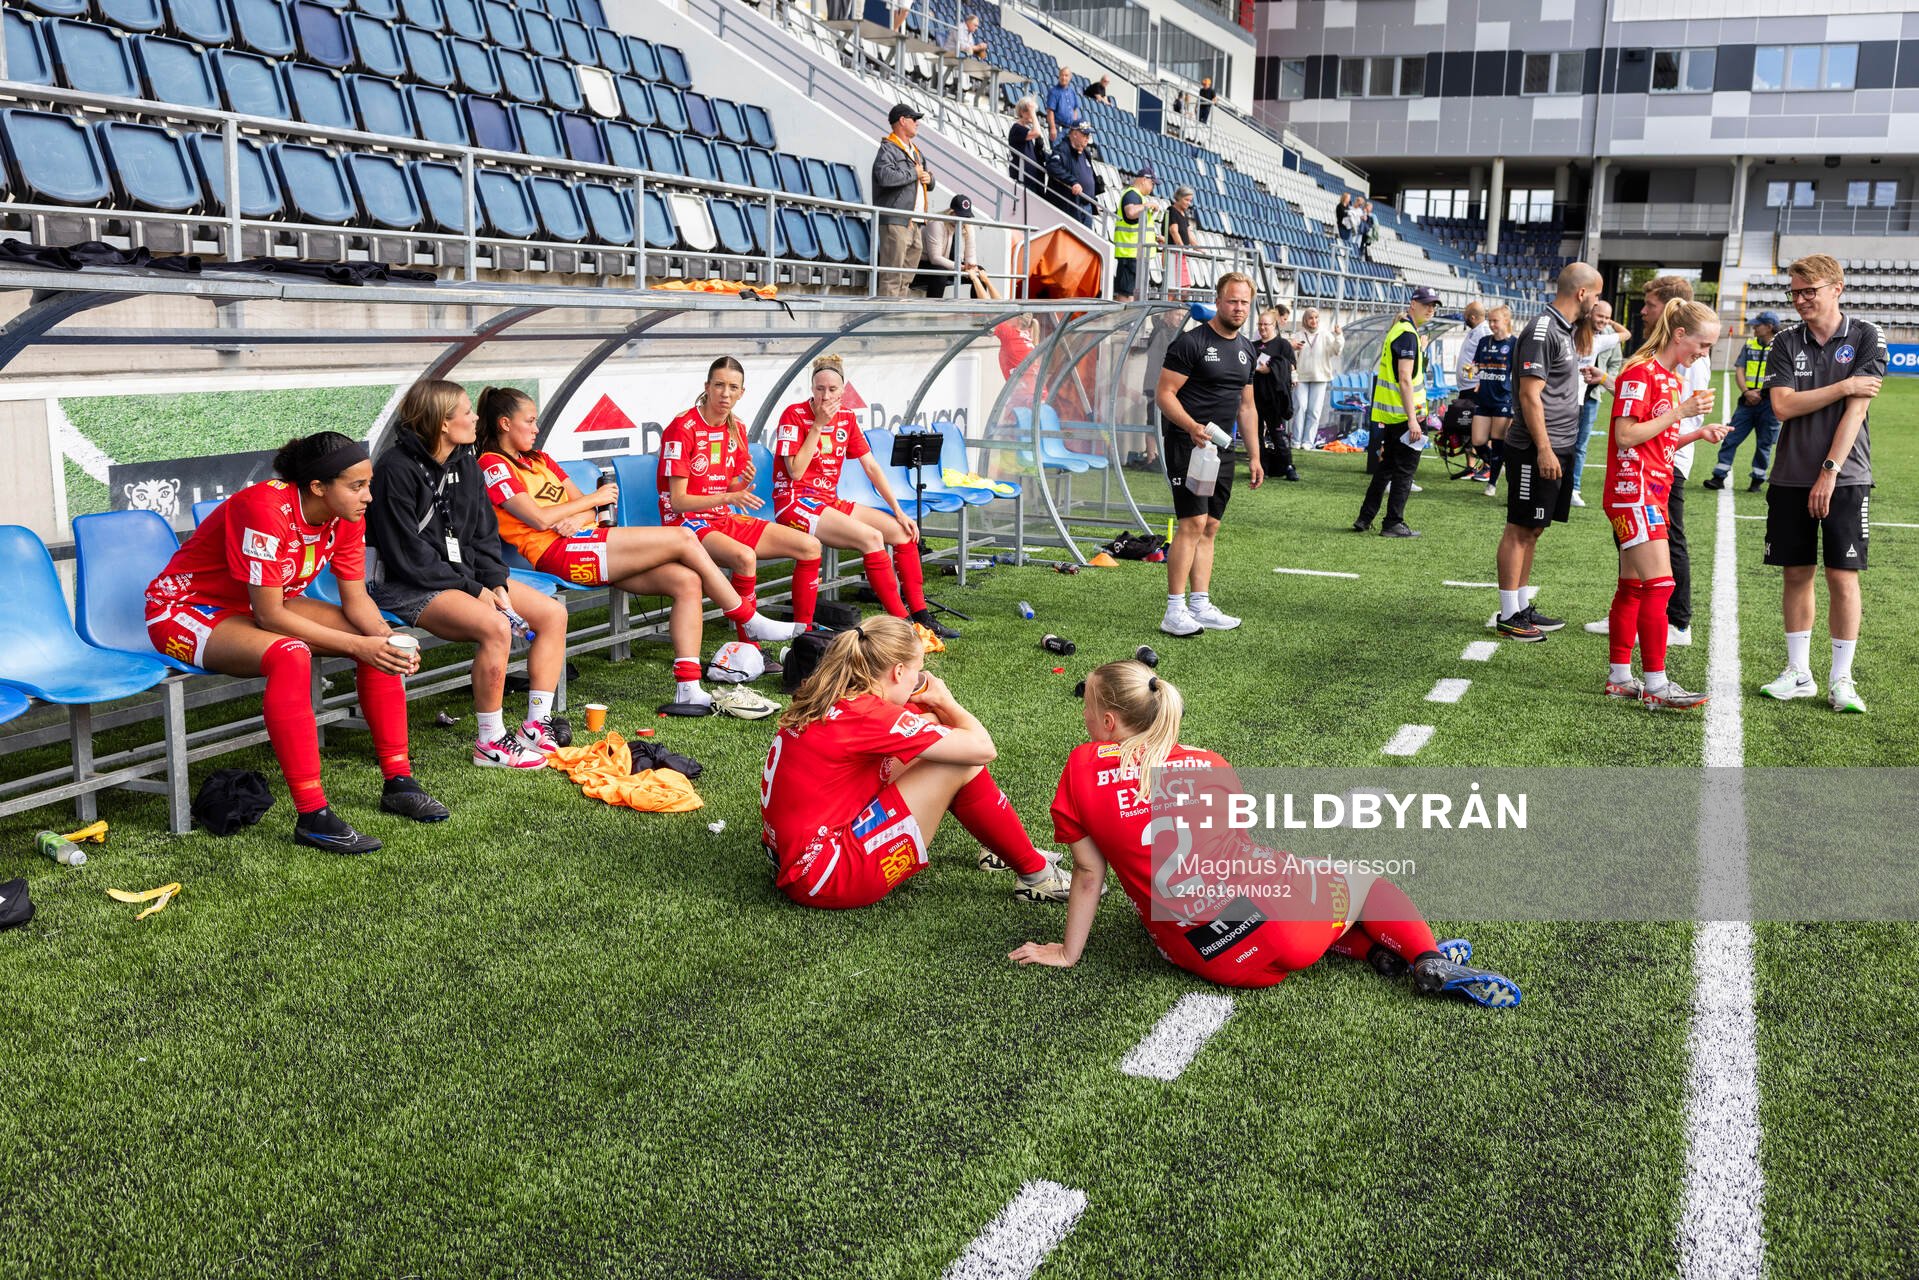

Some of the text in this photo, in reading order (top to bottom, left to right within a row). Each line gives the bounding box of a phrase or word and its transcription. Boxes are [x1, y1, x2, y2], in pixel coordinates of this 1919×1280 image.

[1892, 353, 1919, 367] OB
[1172, 477, 1181, 486] SJ
[1533, 507, 1545, 519] JD
[760, 735, 783, 809] 9
[1097, 756, 1213, 786] BYGTRÖM
[1120, 798, 1200, 818] Passion for presion
[888, 838, 908, 853] umbro
[1141, 816, 1206, 899] 2
[1201, 911, 1263, 956] ÖREBROPORTEN
[1235, 946, 1259, 963] umbro
